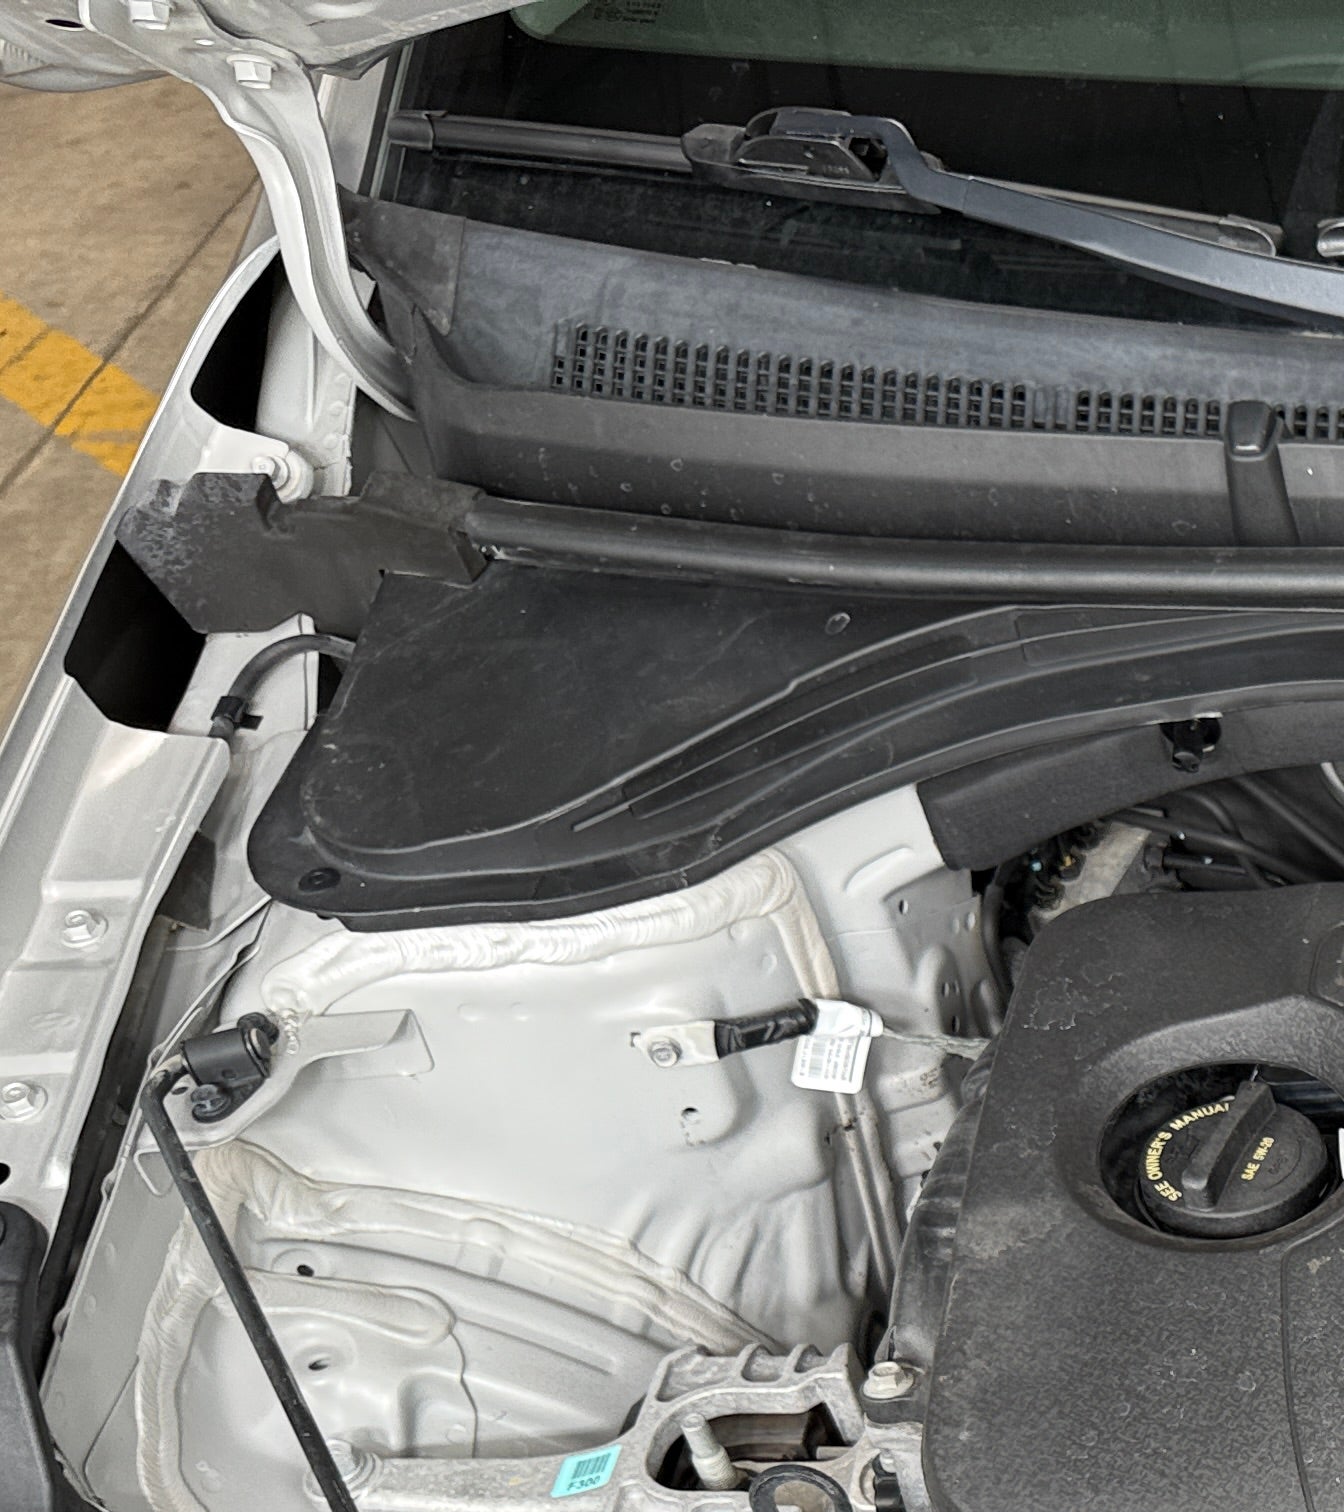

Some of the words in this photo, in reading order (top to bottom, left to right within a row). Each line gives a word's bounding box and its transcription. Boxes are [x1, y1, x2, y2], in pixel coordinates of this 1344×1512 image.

[1145, 1131, 1173, 1181] OWNER'S
[1241, 1161, 1260, 1182] SAE
[1154, 1180, 1184, 1203] SEE
